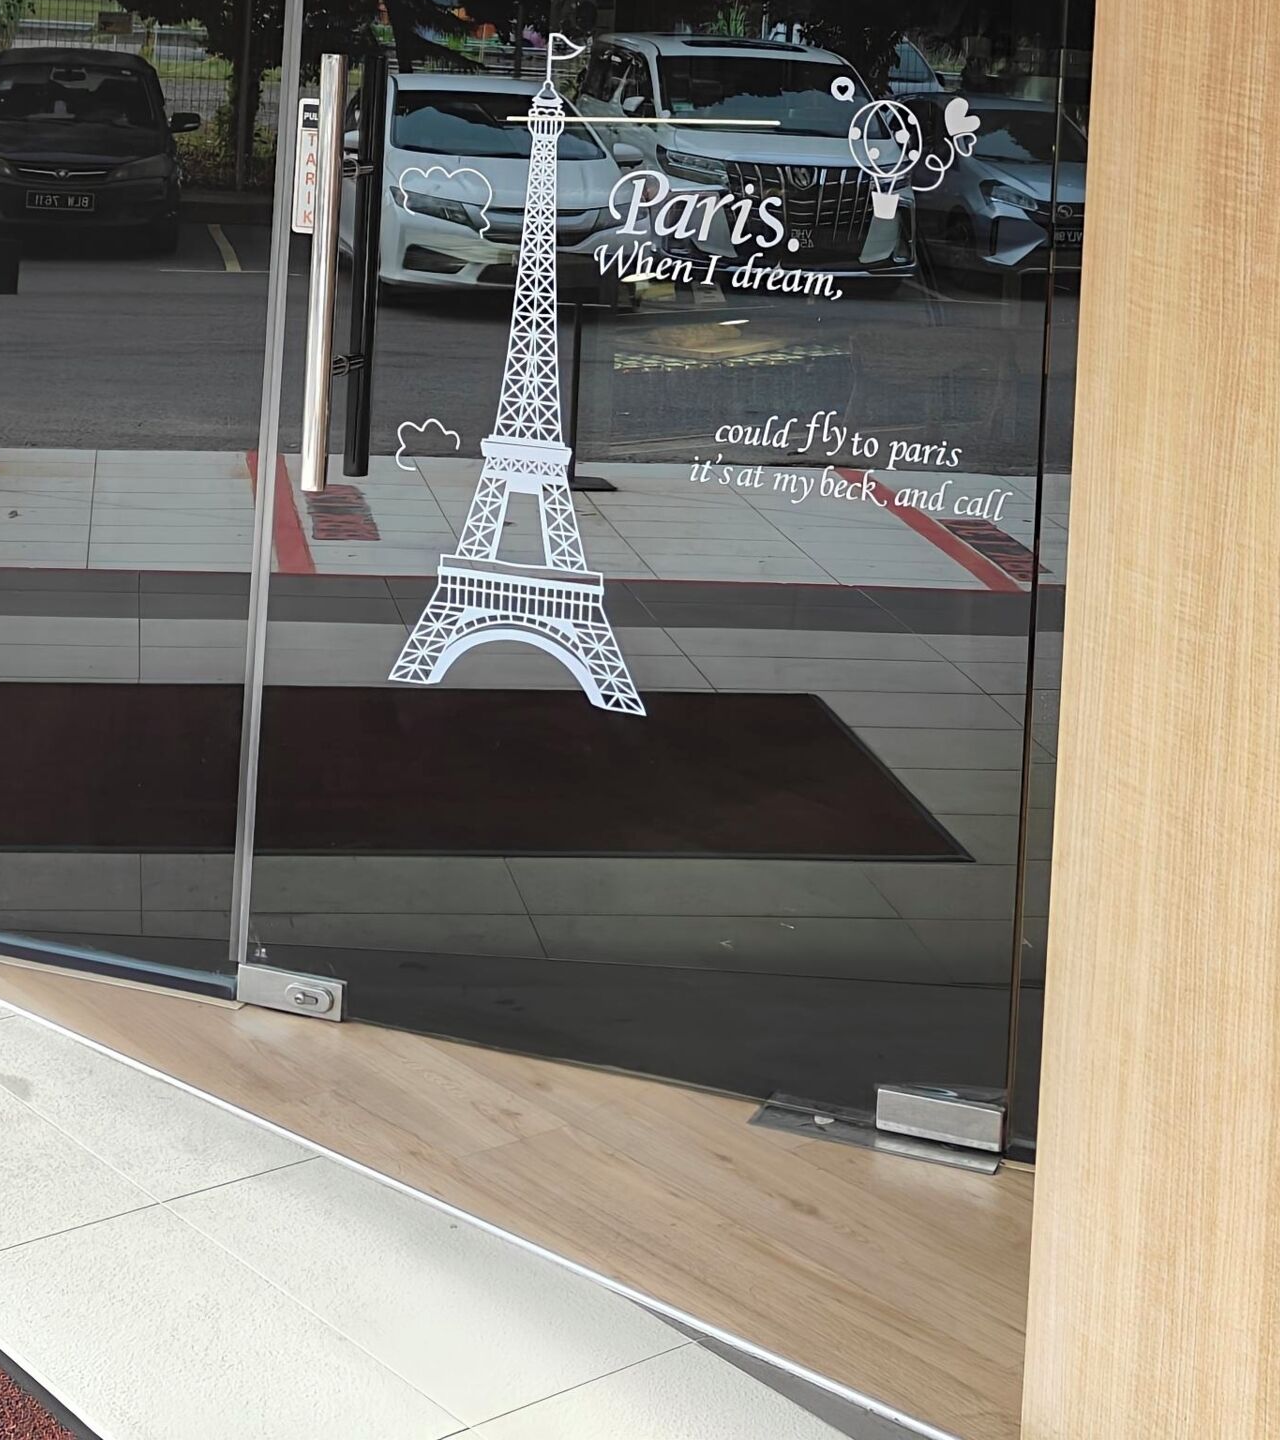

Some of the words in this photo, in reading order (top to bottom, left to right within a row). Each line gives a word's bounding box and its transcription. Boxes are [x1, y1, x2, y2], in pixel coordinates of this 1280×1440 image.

[303, 112, 319, 121] PUL
[608, 170, 800, 253] Paris.
[593, 241, 693, 283] When
[700, 255, 721, 286] I
[731, 252, 843, 300] dream,
[714, 415, 798, 448] could
[797, 410, 847, 456] fly
[851, 432, 879, 458] to
[885, 441, 963, 471] paris
[690, 453, 734, 485] it's
[736, 465, 765, 488] at
[773, 470, 815, 504] my
[820, 465, 888, 507] beck
[894, 480, 953, 512] and
[953, 488, 1014, 522] call
